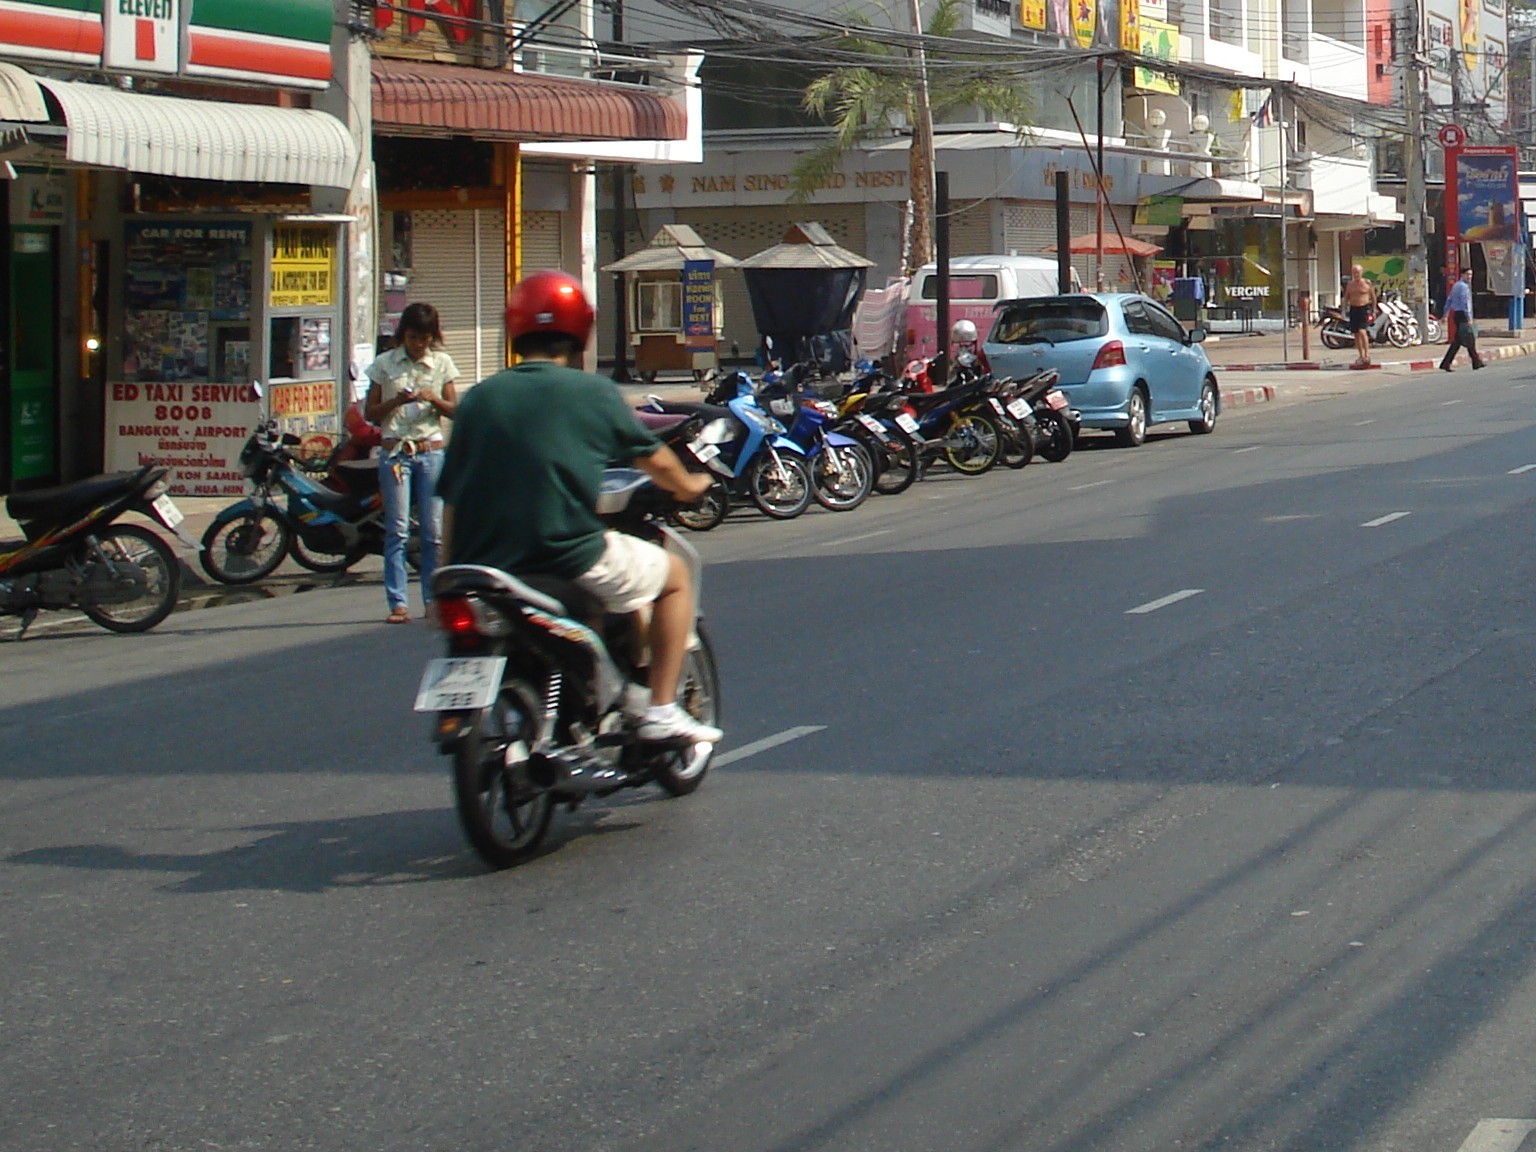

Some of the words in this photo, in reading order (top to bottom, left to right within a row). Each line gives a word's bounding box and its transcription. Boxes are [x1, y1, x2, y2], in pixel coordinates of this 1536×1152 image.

[691, 174, 737, 194] NAM
[742, 173, 791, 192] SING
[853, 169, 908, 189] NEST
[141, 228, 170, 239] CAR
[174, 228, 204, 239] FOR
[207, 228, 247, 240] RENT
[1224, 286, 1270, 297] VERGINE
[112, 383, 140, 402] ED
[144, 383, 184, 402] TAXI
[312, 384, 333, 410] RENT
[119, 425, 180, 437] BANGKOK
[194, 425, 248, 438] AIRPORT
